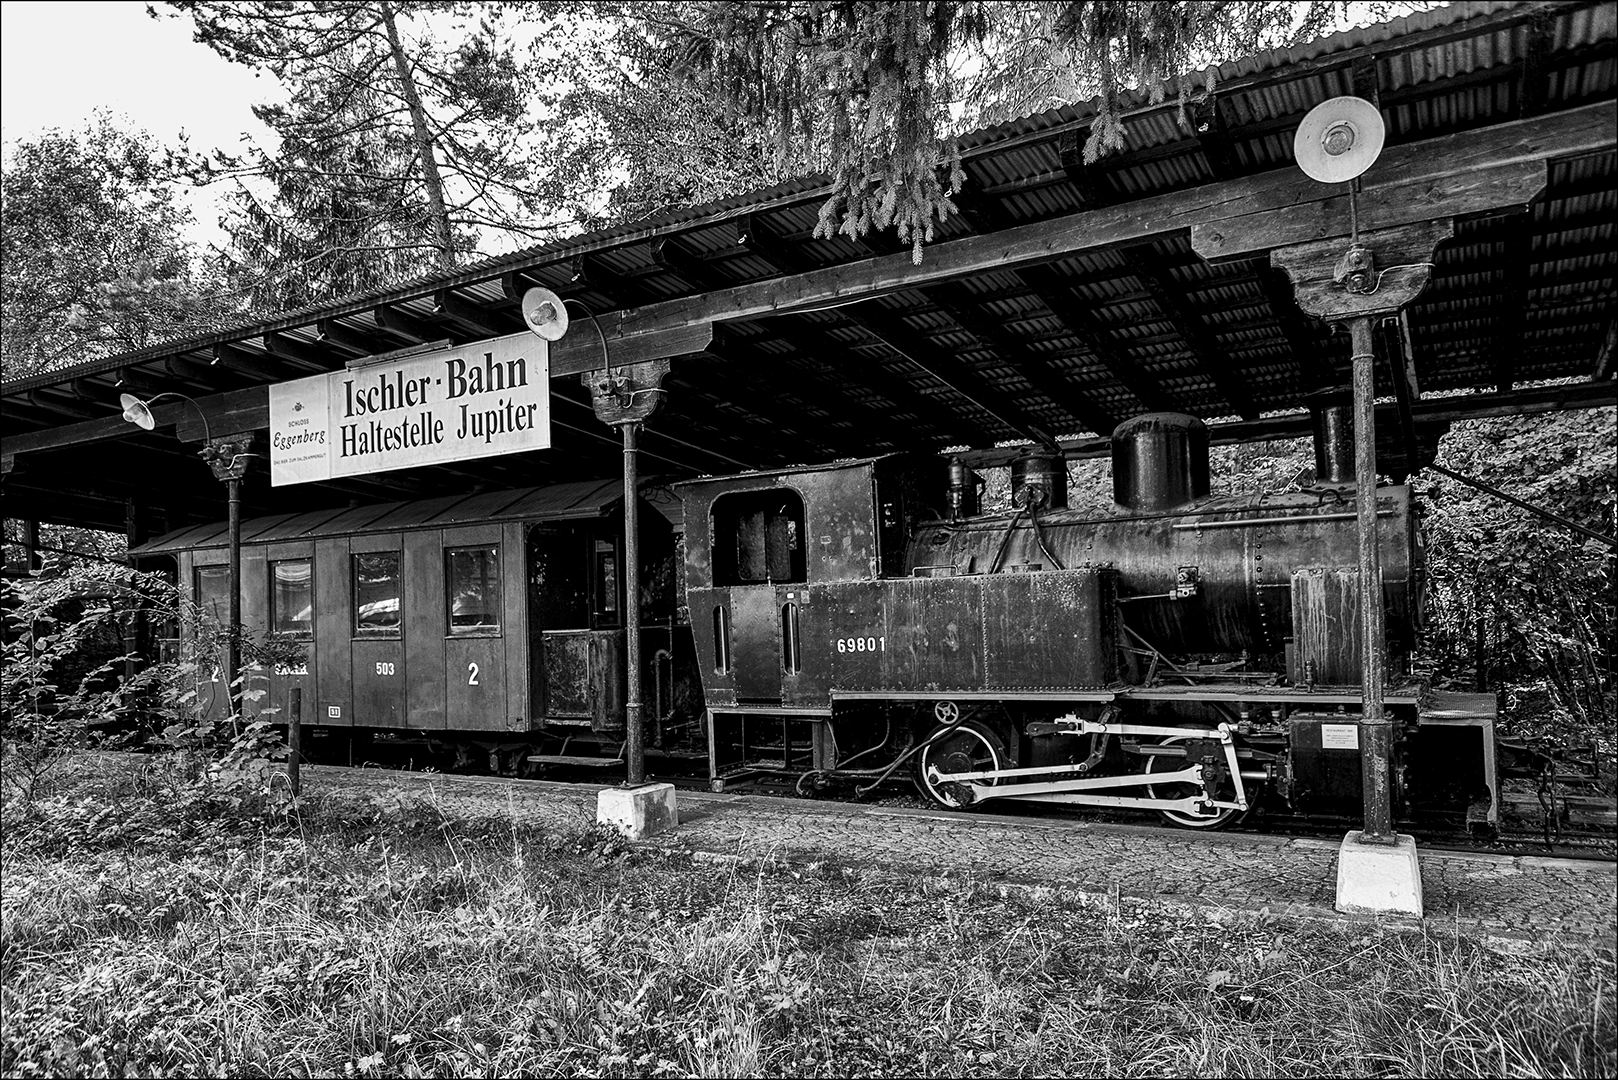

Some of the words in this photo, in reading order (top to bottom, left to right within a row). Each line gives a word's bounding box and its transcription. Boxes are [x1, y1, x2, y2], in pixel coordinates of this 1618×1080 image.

[288, 418, 309, 428] SCHLOSS
[340, 411, 445, 458] Haltestelle
[457, 397, 537, 444] Jupiter
[273, 428, 326, 451] Eggenberg
[837, 636, 885, 653] 69801
[376, 662, 395, 676] 503
[468, 662, 479, 686] 2
